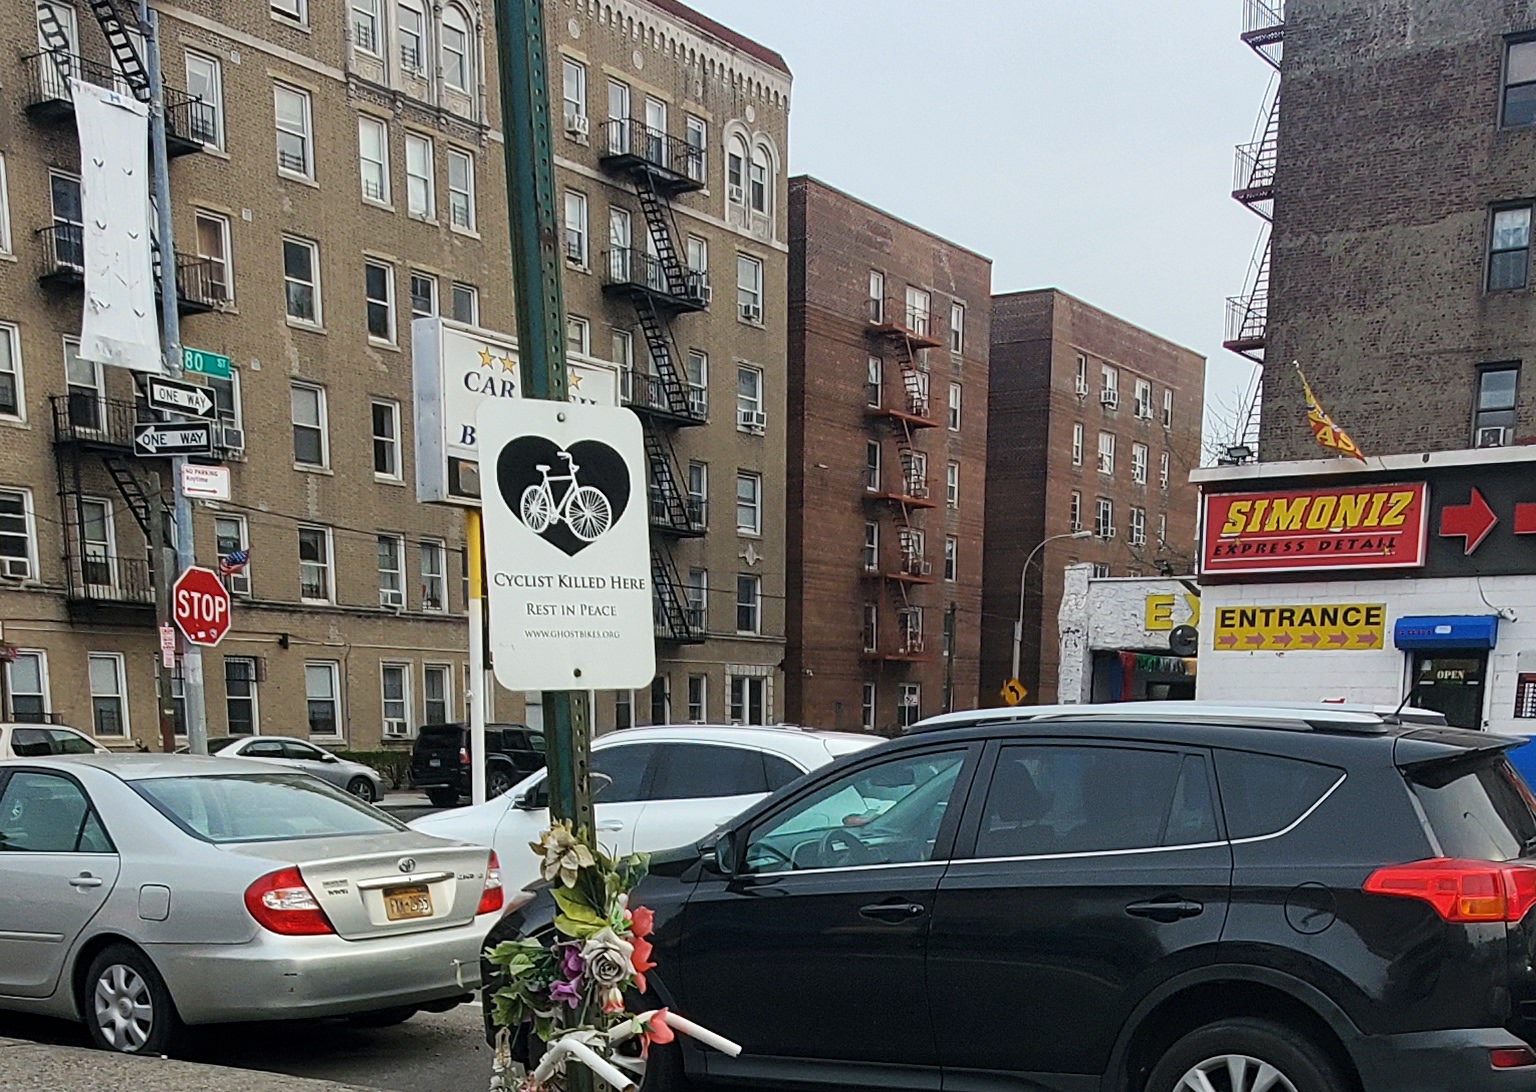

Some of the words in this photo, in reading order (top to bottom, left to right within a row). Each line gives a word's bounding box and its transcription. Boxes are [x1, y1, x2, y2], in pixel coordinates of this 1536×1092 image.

[184, 351, 203, 372] 80
[216, 357, 226, 369] ST
[463, 371, 516, 399] CAR
[158, 388, 180, 403] ONE
[186, 393, 206, 409] WAY
[142, 433, 167, 446] ONE
[179, 432, 204, 445] WAY
[1219, 490, 1415, 535] SIMONIZ
[1212, 540, 1306, 557] EXPRESS
[1318, 537, 1396, 552] DETAIL
[493, 572, 554, 589] CYCLIST
[557, 573, 606, 590] KILLED
[610, 575, 646, 590] HERE
[177, 589, 226, 623] STOP
[526, 602, 558, 616] REST
[561, 603, 576, 616] IN
[580, 603, 617, 617] PEACE
[1219, 606, 1382, 629] ENTRANCE
[1436, 669, 1466, 680] OPEN
